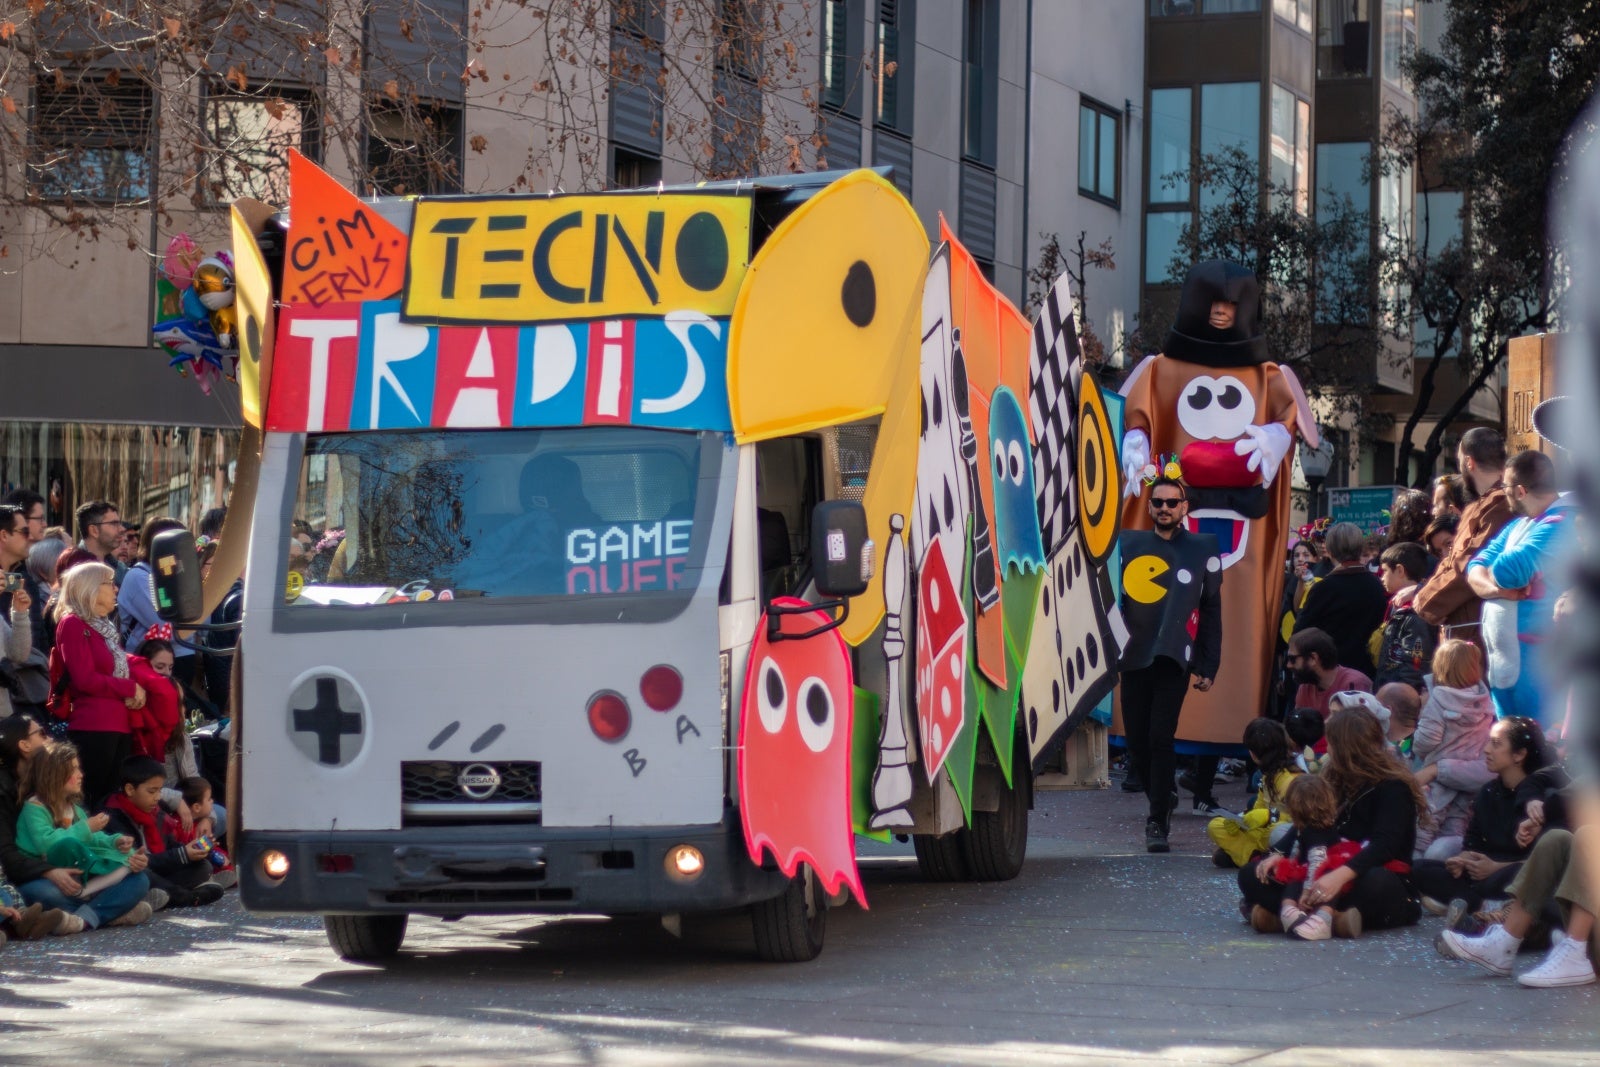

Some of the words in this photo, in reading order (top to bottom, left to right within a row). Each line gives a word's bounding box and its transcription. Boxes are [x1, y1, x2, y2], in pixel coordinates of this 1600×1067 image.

[430, 210, 730, 306] TECNO
[566, 520, 694, 564] GAME
[461, 775, 495, 784] NISSAN
[622, 748, 647, 777] B
